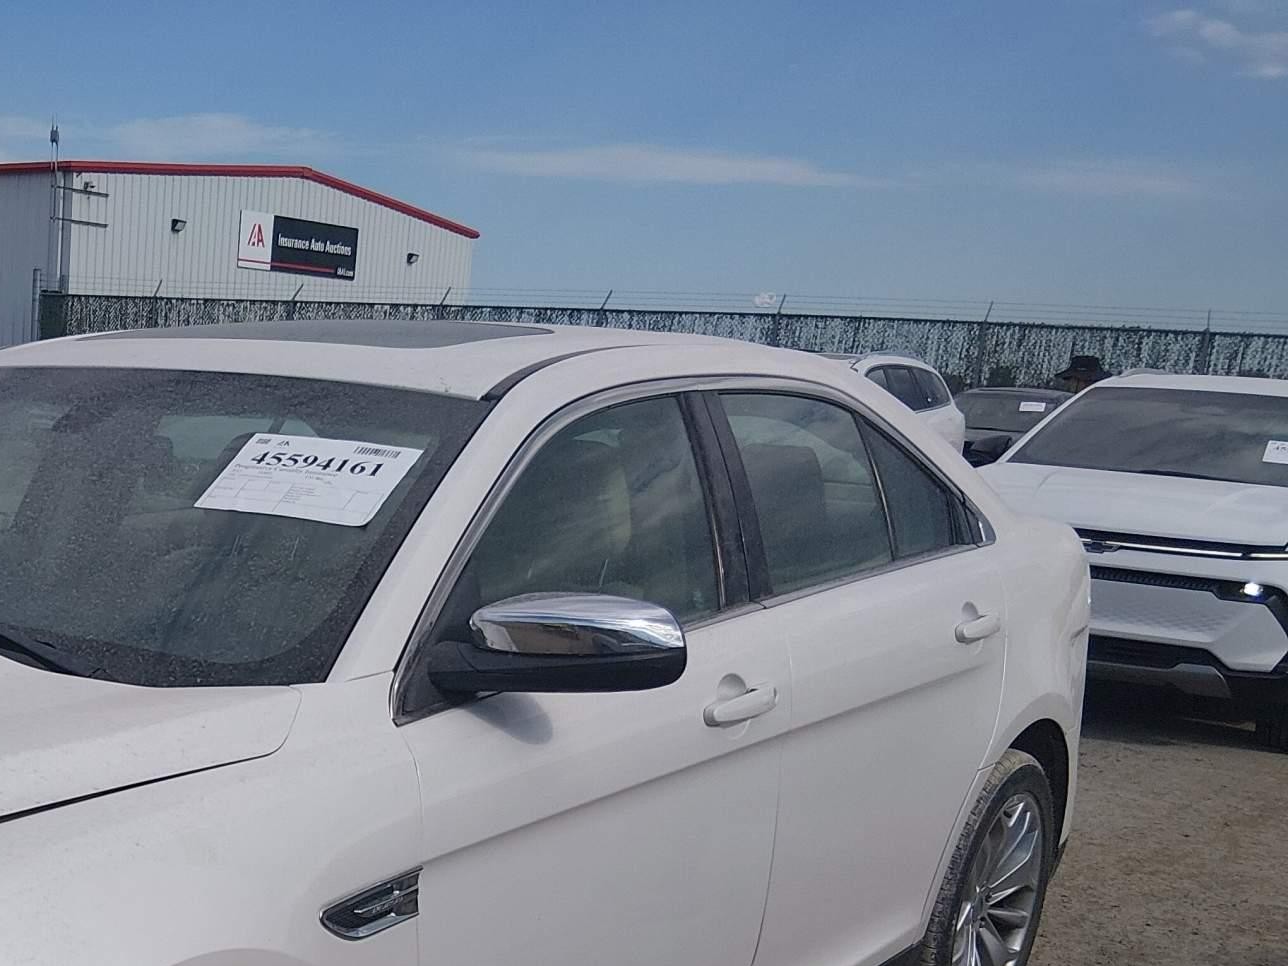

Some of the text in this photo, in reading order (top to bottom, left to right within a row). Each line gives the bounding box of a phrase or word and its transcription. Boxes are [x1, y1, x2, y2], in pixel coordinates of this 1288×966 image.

[277, 233, 352, 256] Insurance Auto Auctions
[250, 450, 385, 477] 45594161
